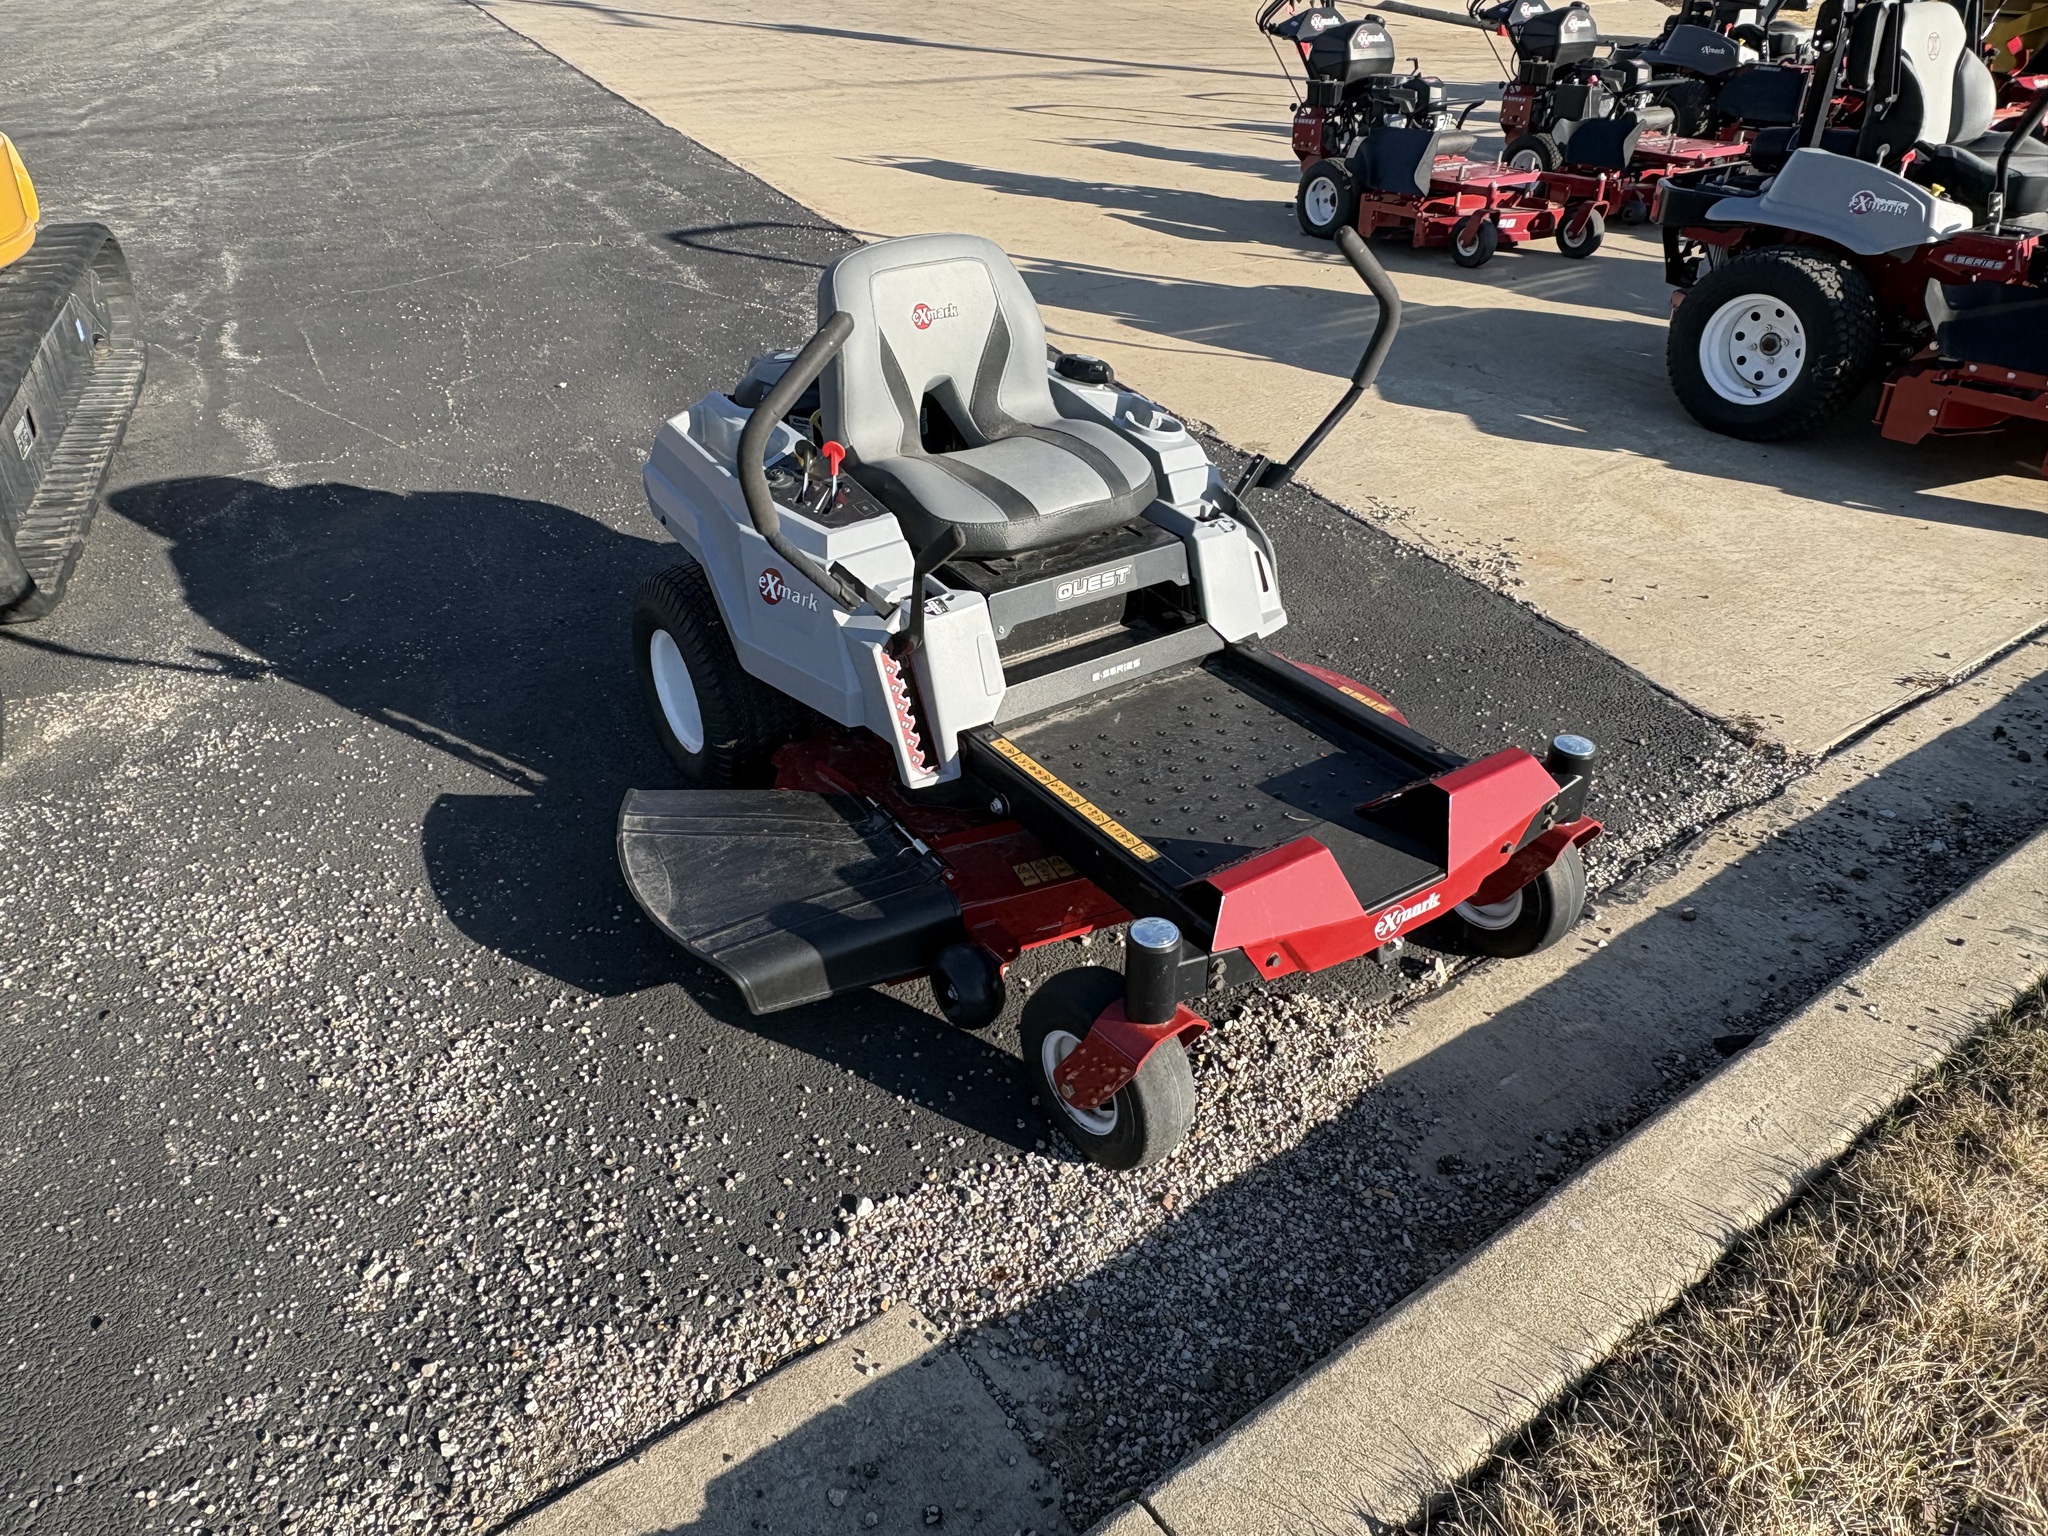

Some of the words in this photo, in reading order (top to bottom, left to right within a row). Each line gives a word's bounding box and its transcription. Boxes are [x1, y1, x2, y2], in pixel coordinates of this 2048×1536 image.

[1849, 190, 1909, 216] eXmark
[912, 303, 958, 328] eXmark
[758, 570, 819, 612] eXmark
[1056, 565, 1131, 602] QUEST
[1374, 892, 1441, 938] eXmark
